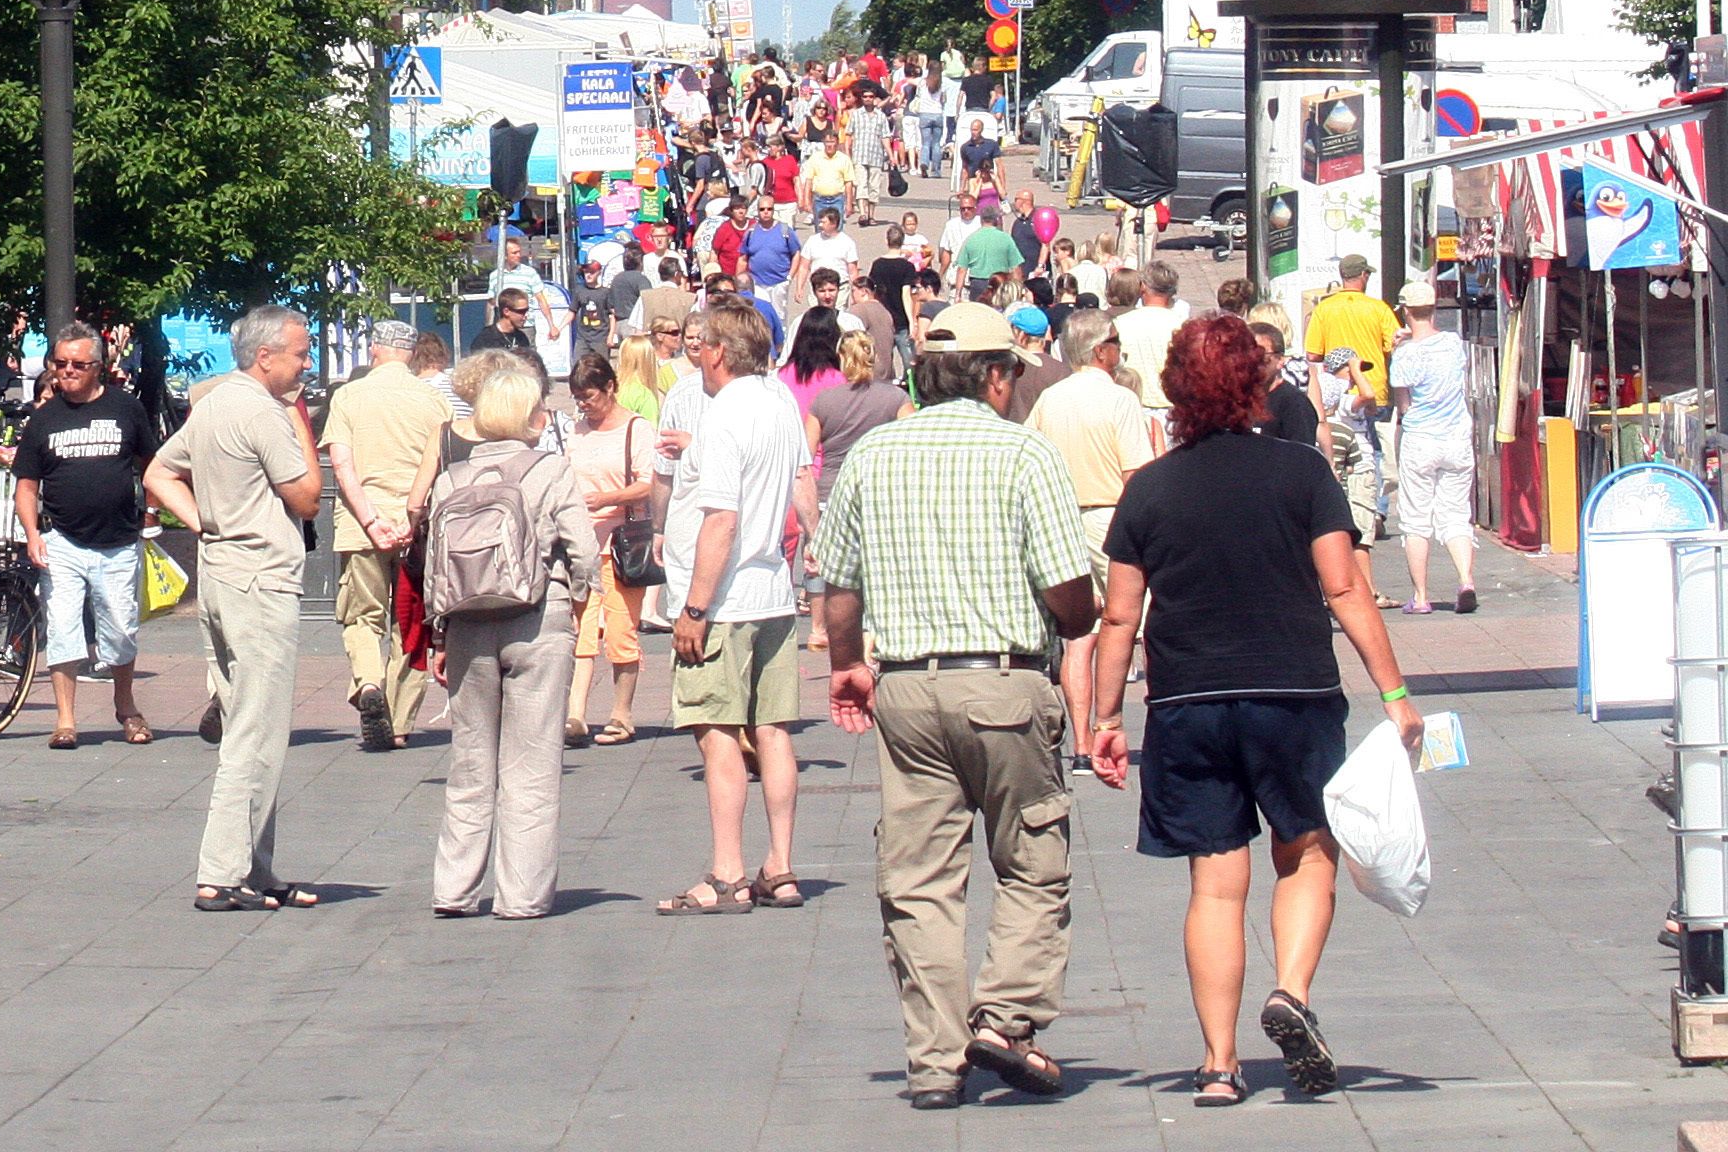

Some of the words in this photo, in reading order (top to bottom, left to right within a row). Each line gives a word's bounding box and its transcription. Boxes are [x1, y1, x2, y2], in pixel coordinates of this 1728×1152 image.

[581, 78, 615, 91] KALA
[566, 91, 630, 105] SPECIAALI
[48, 427, 123, 450] THOROGOOD
